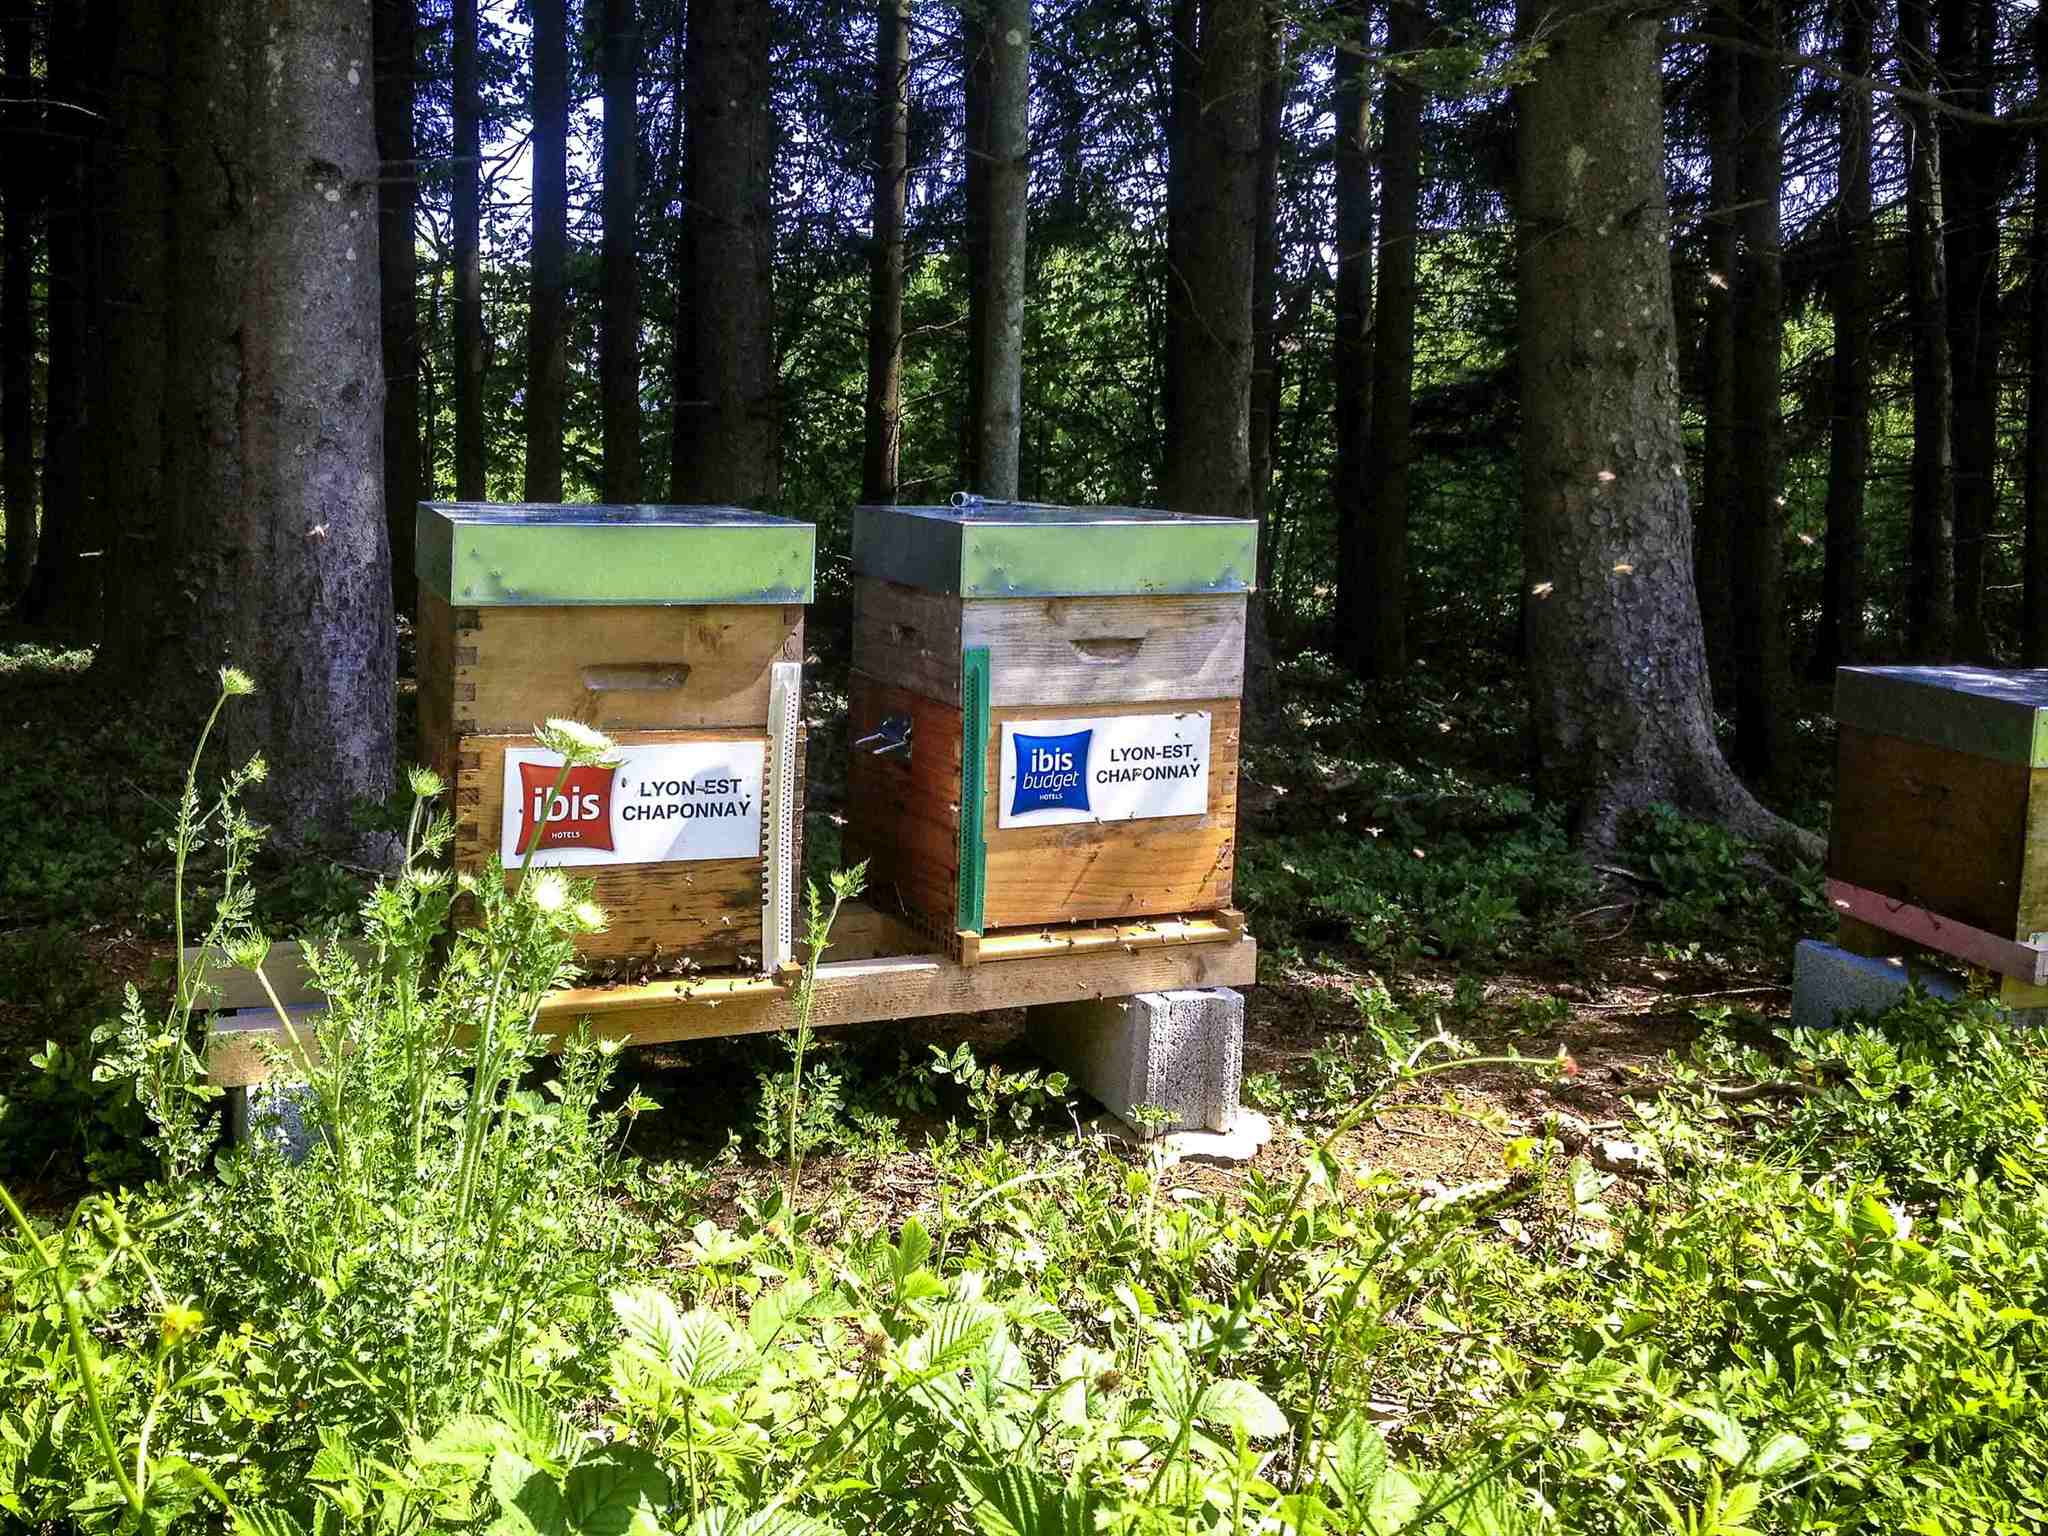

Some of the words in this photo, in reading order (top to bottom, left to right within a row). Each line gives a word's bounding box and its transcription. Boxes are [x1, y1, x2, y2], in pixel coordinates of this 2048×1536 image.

[1031, 747, 1073, 773] ibis
[1110, 744, 1193, 762] LYON-EST
[1023, 770, 1080, 792] budget
[1096, 764, 1201, 784] CHAPONNAY
[639, 778, 742, 797] LYON-EST
[1039, 793, 1063, 801] HOTELS
[532, 786, 601, 823] ibis
[622, 801, 751, 821] CHAPONNAY
[551, 831, 581, 839] HOTELS
